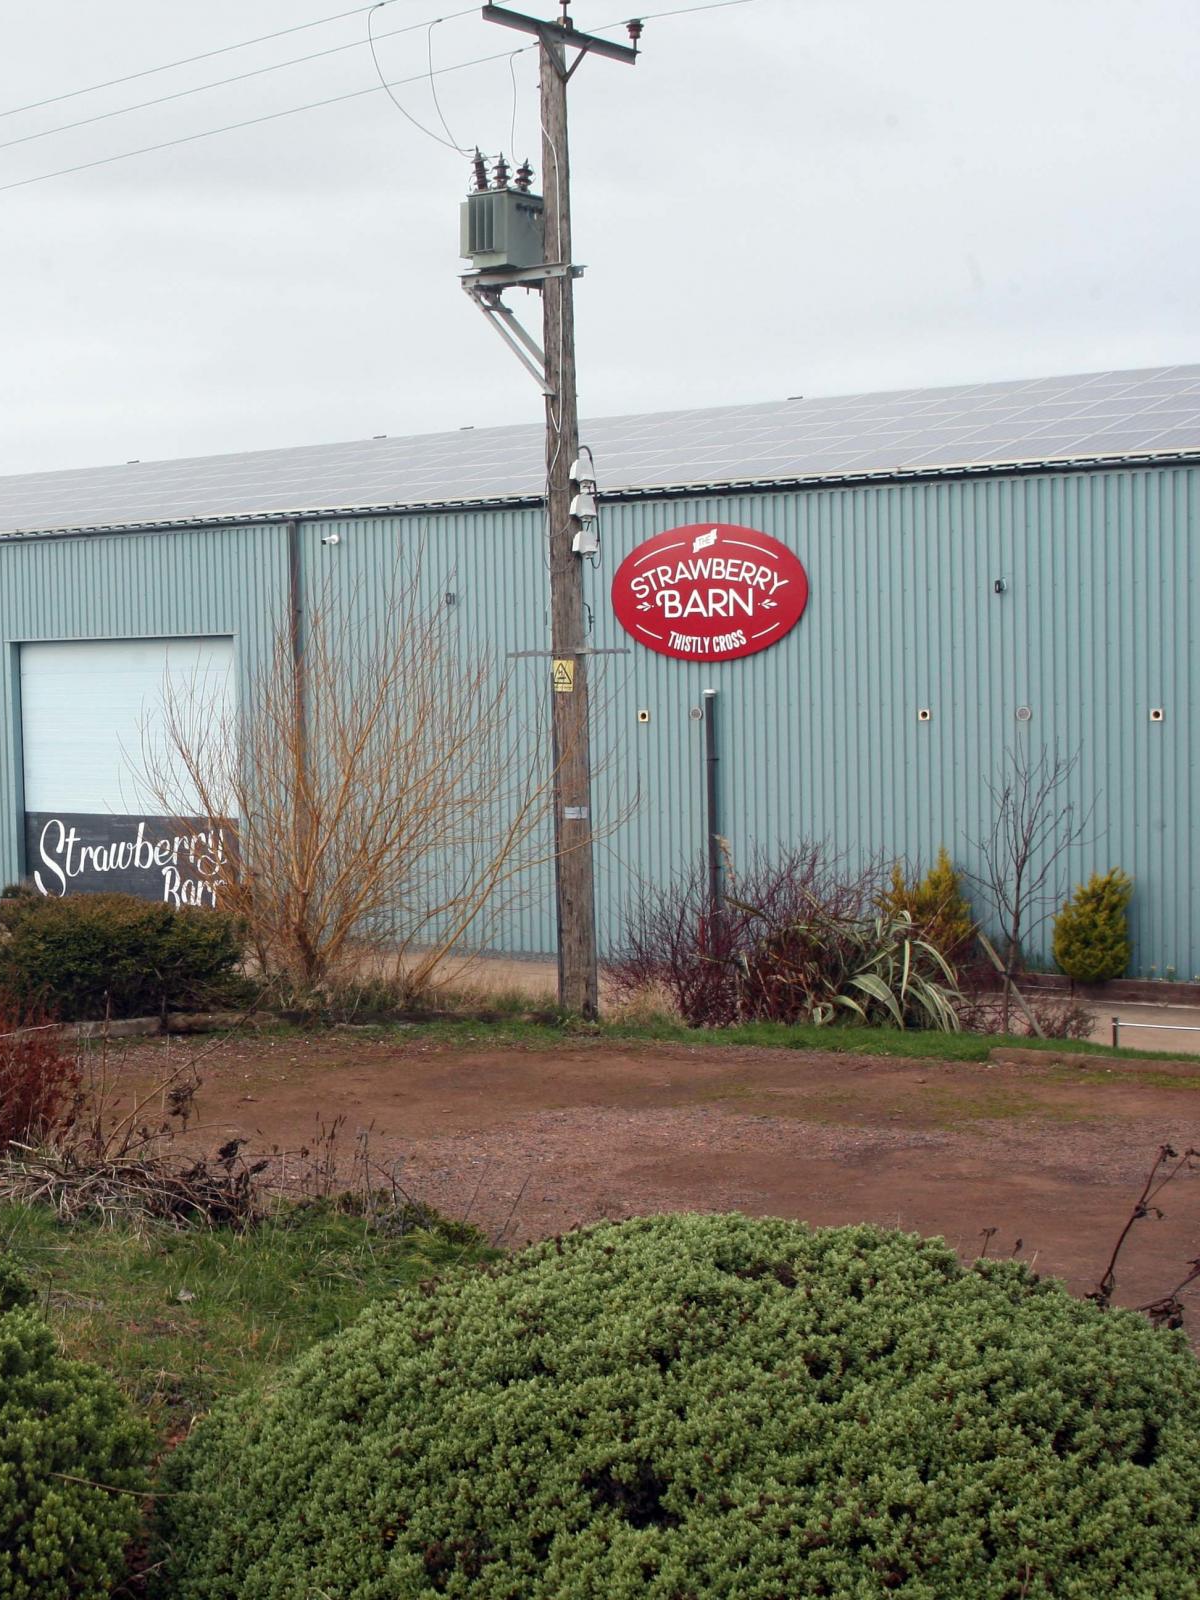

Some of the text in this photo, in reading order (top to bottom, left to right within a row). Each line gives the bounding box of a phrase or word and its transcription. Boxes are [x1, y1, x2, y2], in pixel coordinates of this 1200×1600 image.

[631, 558, 789, 599] STRAWBERRY
[655, 588, 753, 618] BARN
[668, 629, 747, 653] THISTLY CROSS
[34, 819, 227, 897] Strawberry
